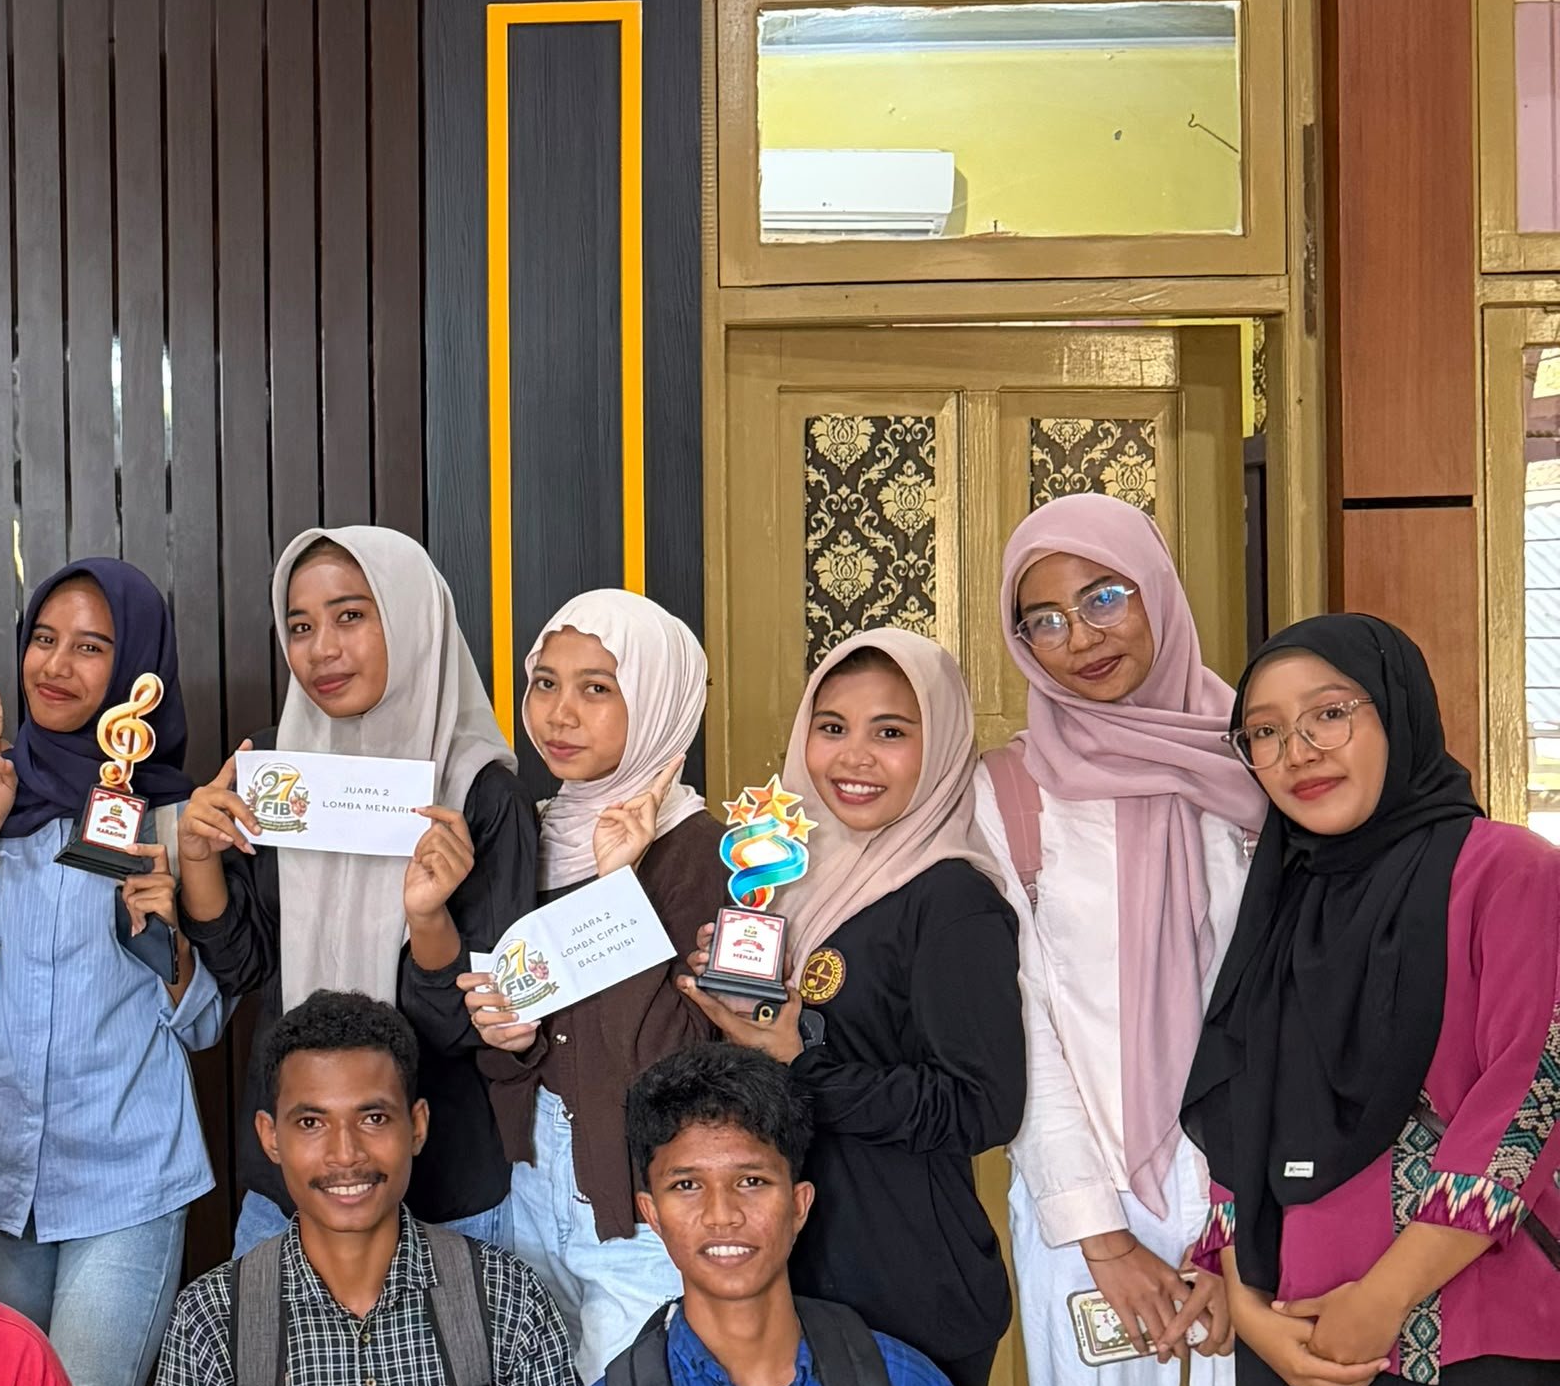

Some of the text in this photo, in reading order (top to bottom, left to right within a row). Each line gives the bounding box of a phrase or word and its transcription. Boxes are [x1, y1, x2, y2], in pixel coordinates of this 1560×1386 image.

[343, 786, 389, 797] JUARA 2
[261, 801, 291, 816] FIB
[322, 800, 361, 810] LOMBA
[571, 917, 602, 936] JUARA
[560, 938, 595, 958] LOMBA
[597, 923, 627, 941] CIPTA
[577, 952, 606, 968] BACA
[505, 974, 537, 996] FIB
